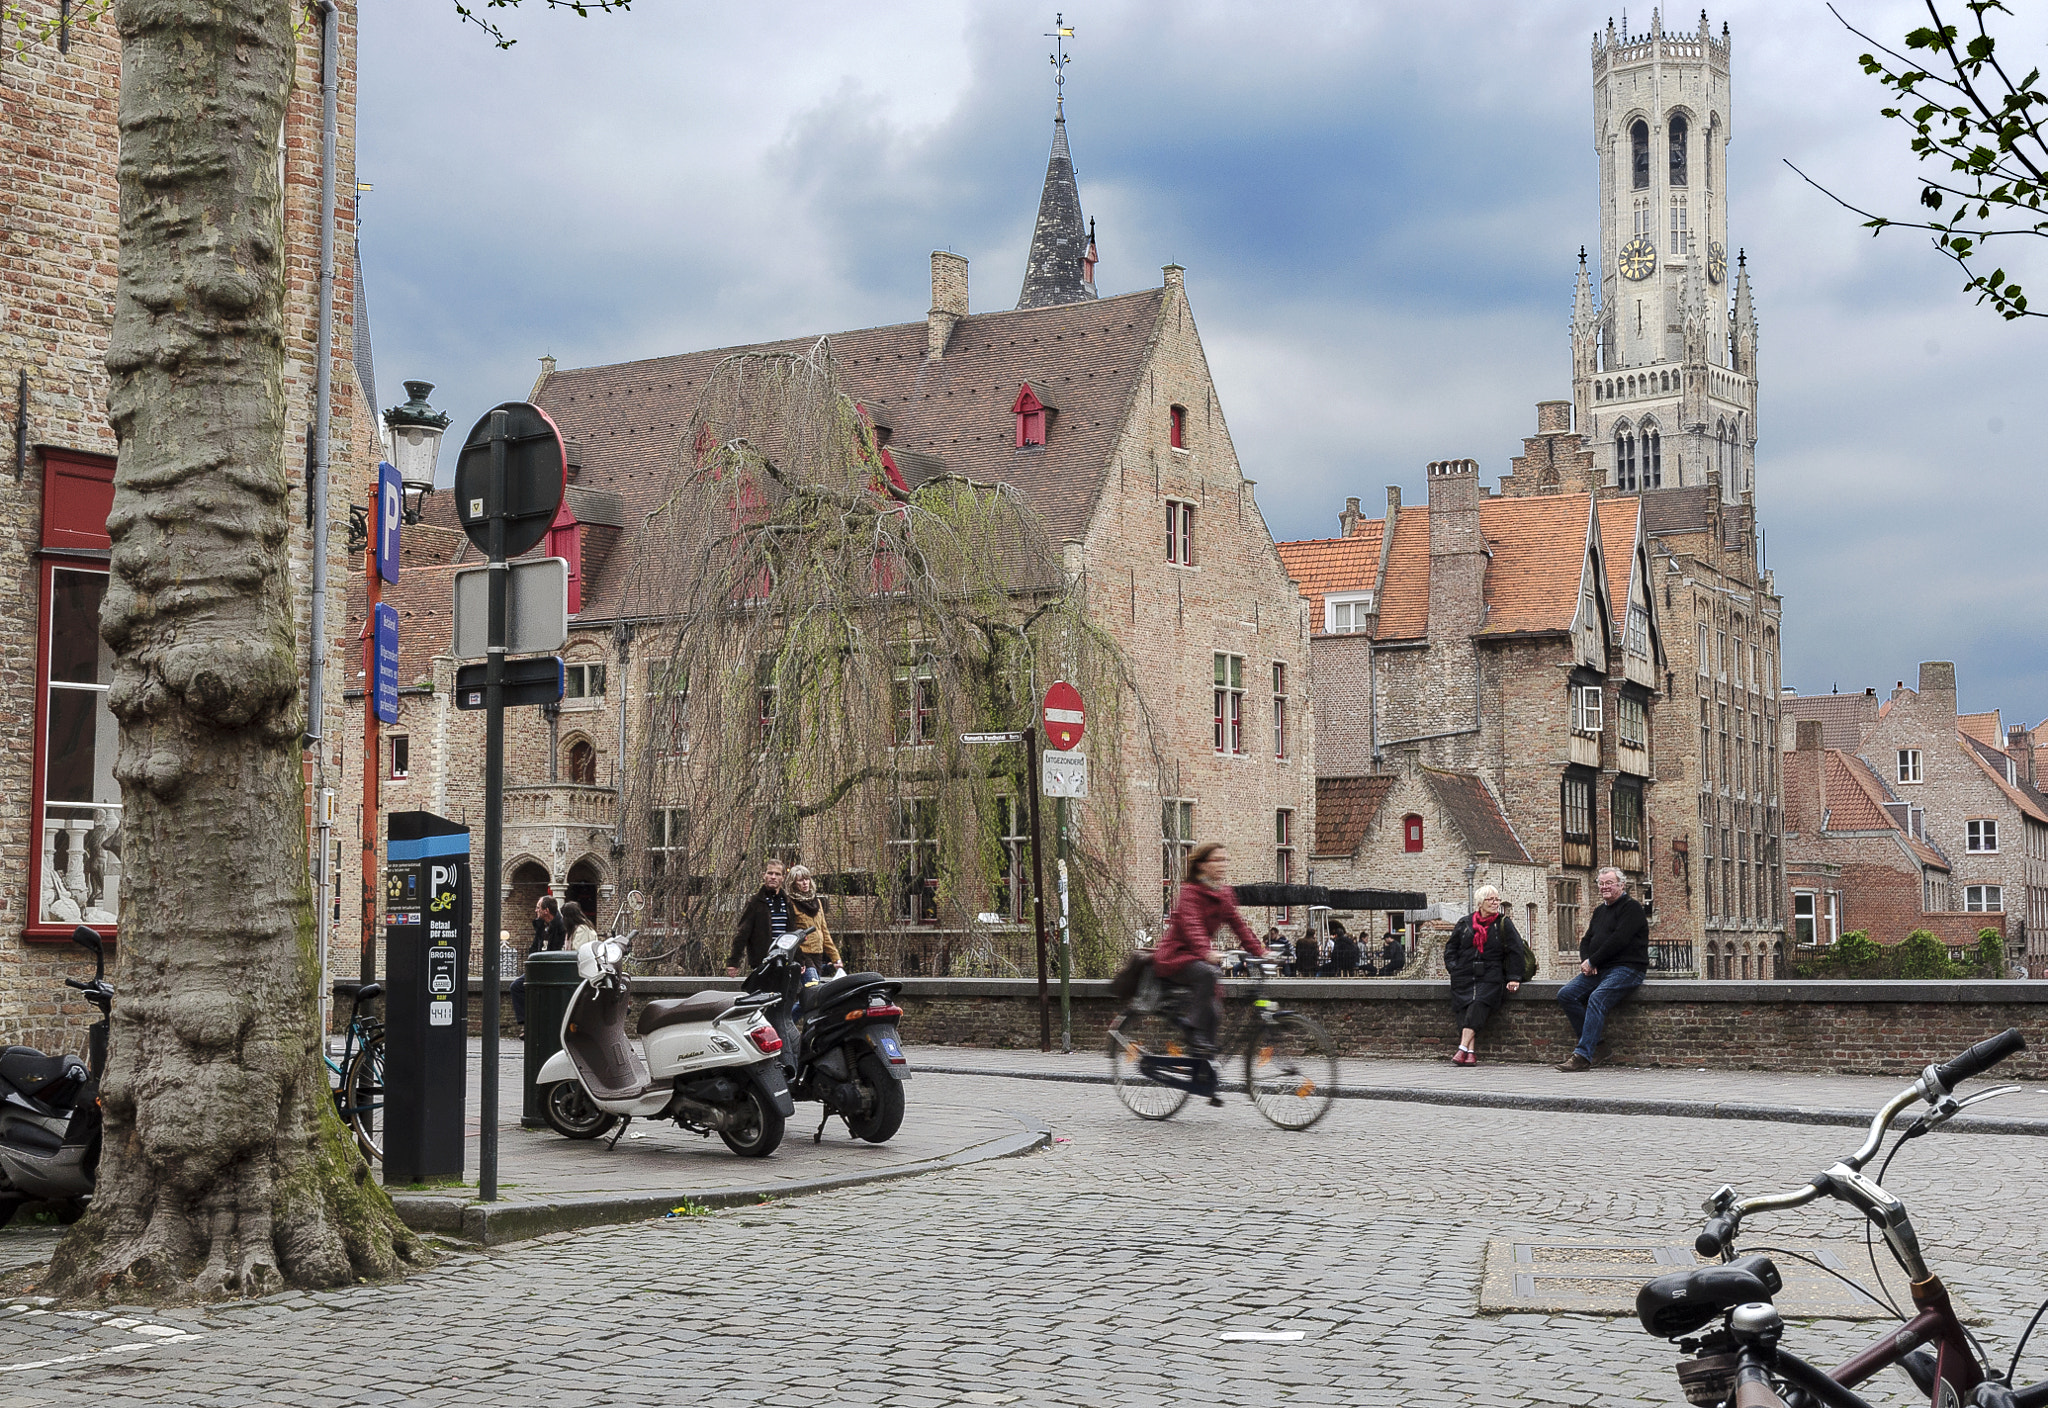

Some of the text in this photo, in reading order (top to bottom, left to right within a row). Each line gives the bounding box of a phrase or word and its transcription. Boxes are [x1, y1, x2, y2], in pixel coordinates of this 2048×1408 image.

[384, 480, 400, 561] P
[1045, 755, 1085, 766] UITGEZONDERD
[431, 865, 449, 898] P
[430, 920, 451, 929] Betaal
[430, 928, 457, 939] per sms!
[431, 1008, 452, 1018] 4411
